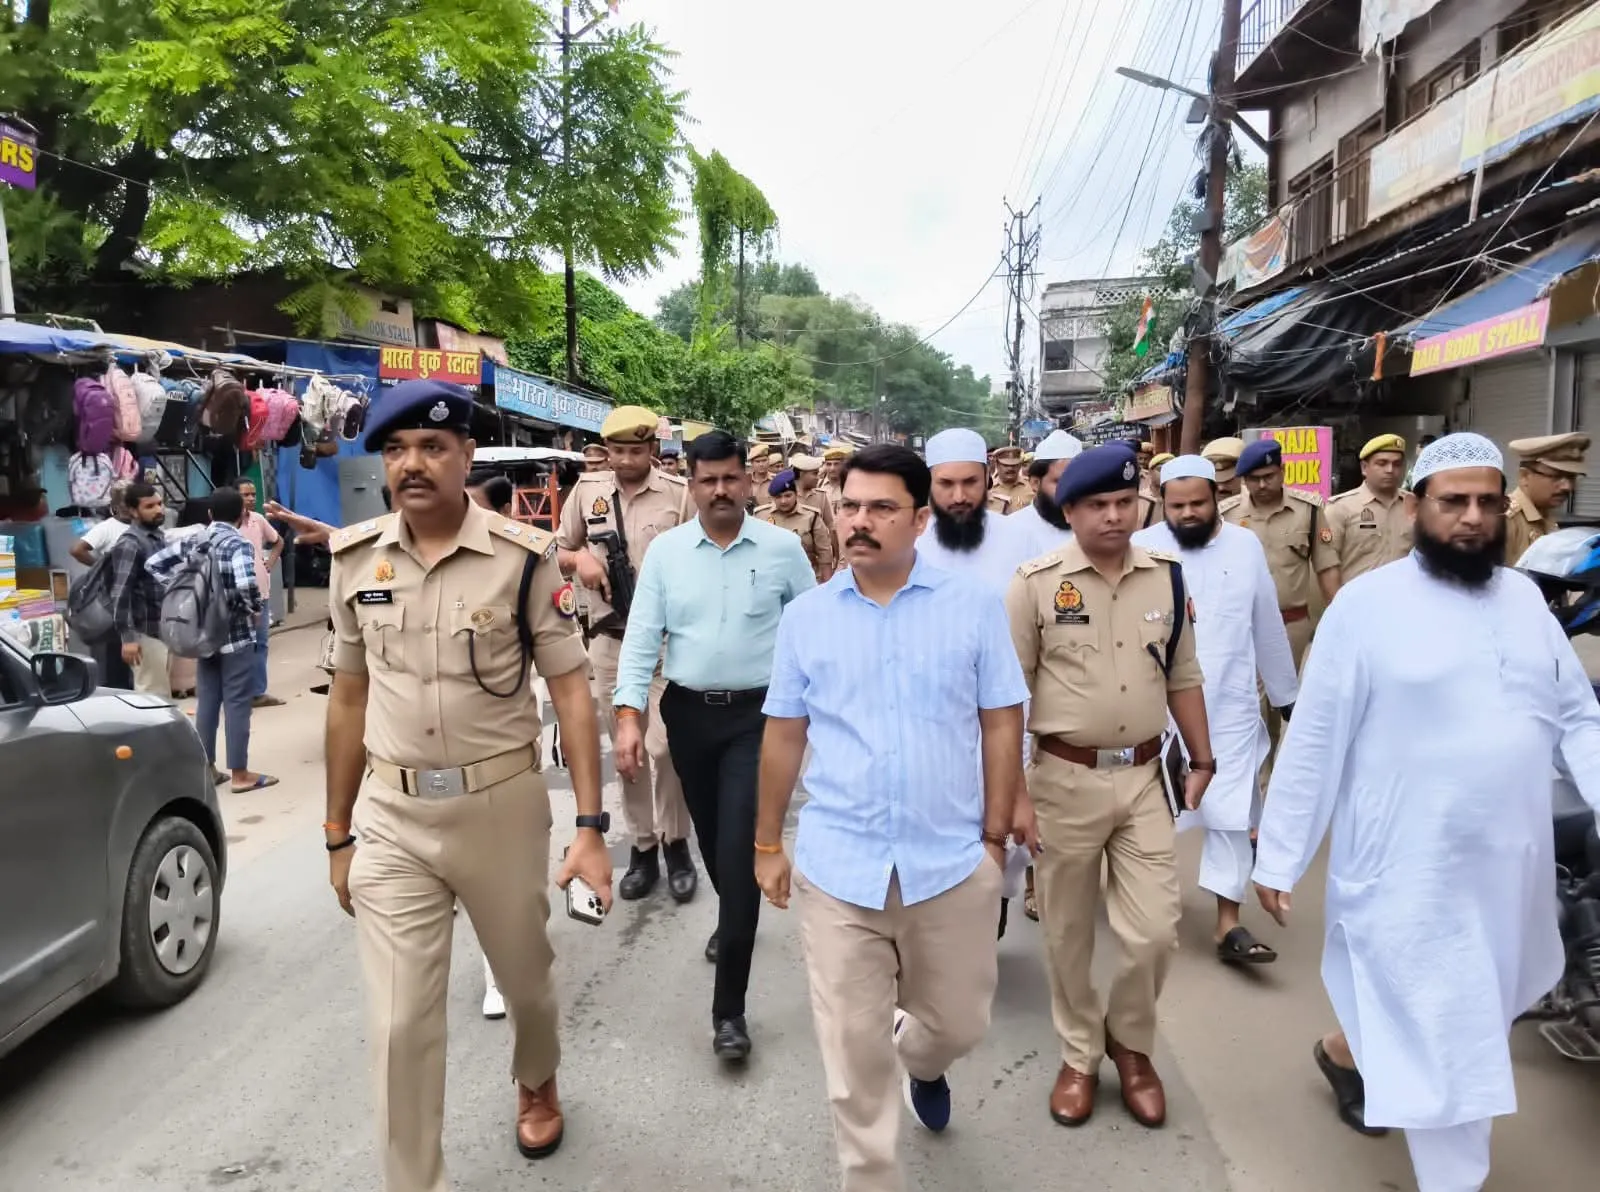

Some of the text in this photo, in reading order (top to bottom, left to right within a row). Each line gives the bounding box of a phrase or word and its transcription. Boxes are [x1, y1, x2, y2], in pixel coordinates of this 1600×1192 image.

[0, 136, 34, 172] RS
[368, 319, 386, 337] OOK
[388, 324, 413, 342] STALL
[1486, 314, 1540, 353] STALL
[382, 347, 414, 370] भारत
[418, 350, 442, 379] बुक
[512, 377, 547, 408] भारत
[1273, 428, 1318, 454] RAJA
[1283, 460, 1321, 486] OOK
